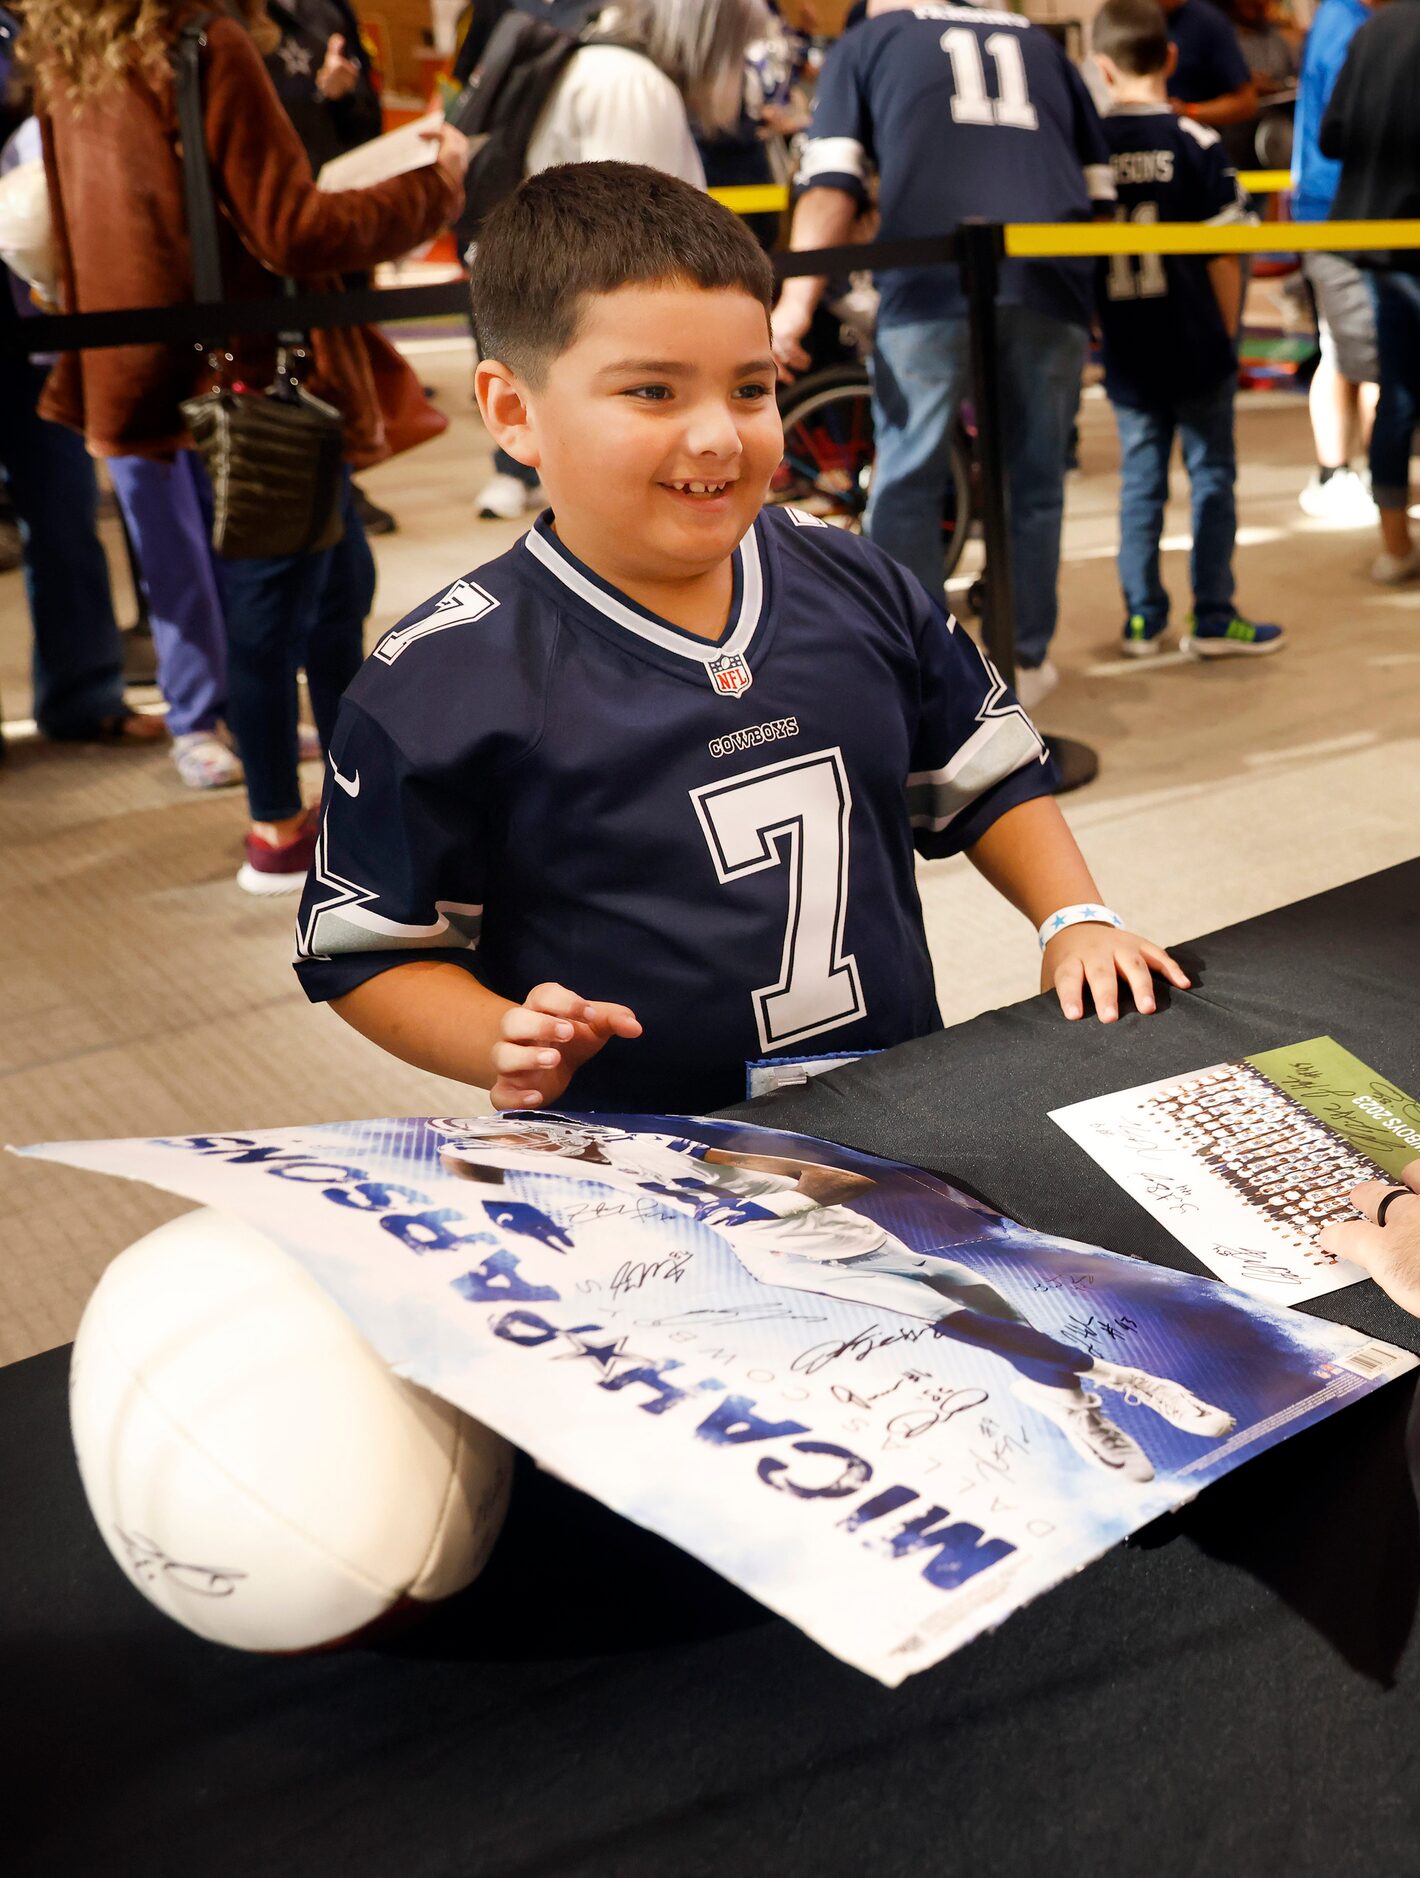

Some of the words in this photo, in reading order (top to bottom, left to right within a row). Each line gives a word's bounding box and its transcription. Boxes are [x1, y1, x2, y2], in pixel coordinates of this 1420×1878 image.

[940, 27, 1039, 130] 11
[373, 579, 500, 666] 7
[716, 668, 747, 690] NFL
[708, 716, 800, 757] COWBOYS
[688, 746, 867, 1053] 7
[1351, 1094, 1394, 1121] 2023
[148, 1136, 604, 1347] PARSONS
[598, 1358, 1019, 1590] MICAH
